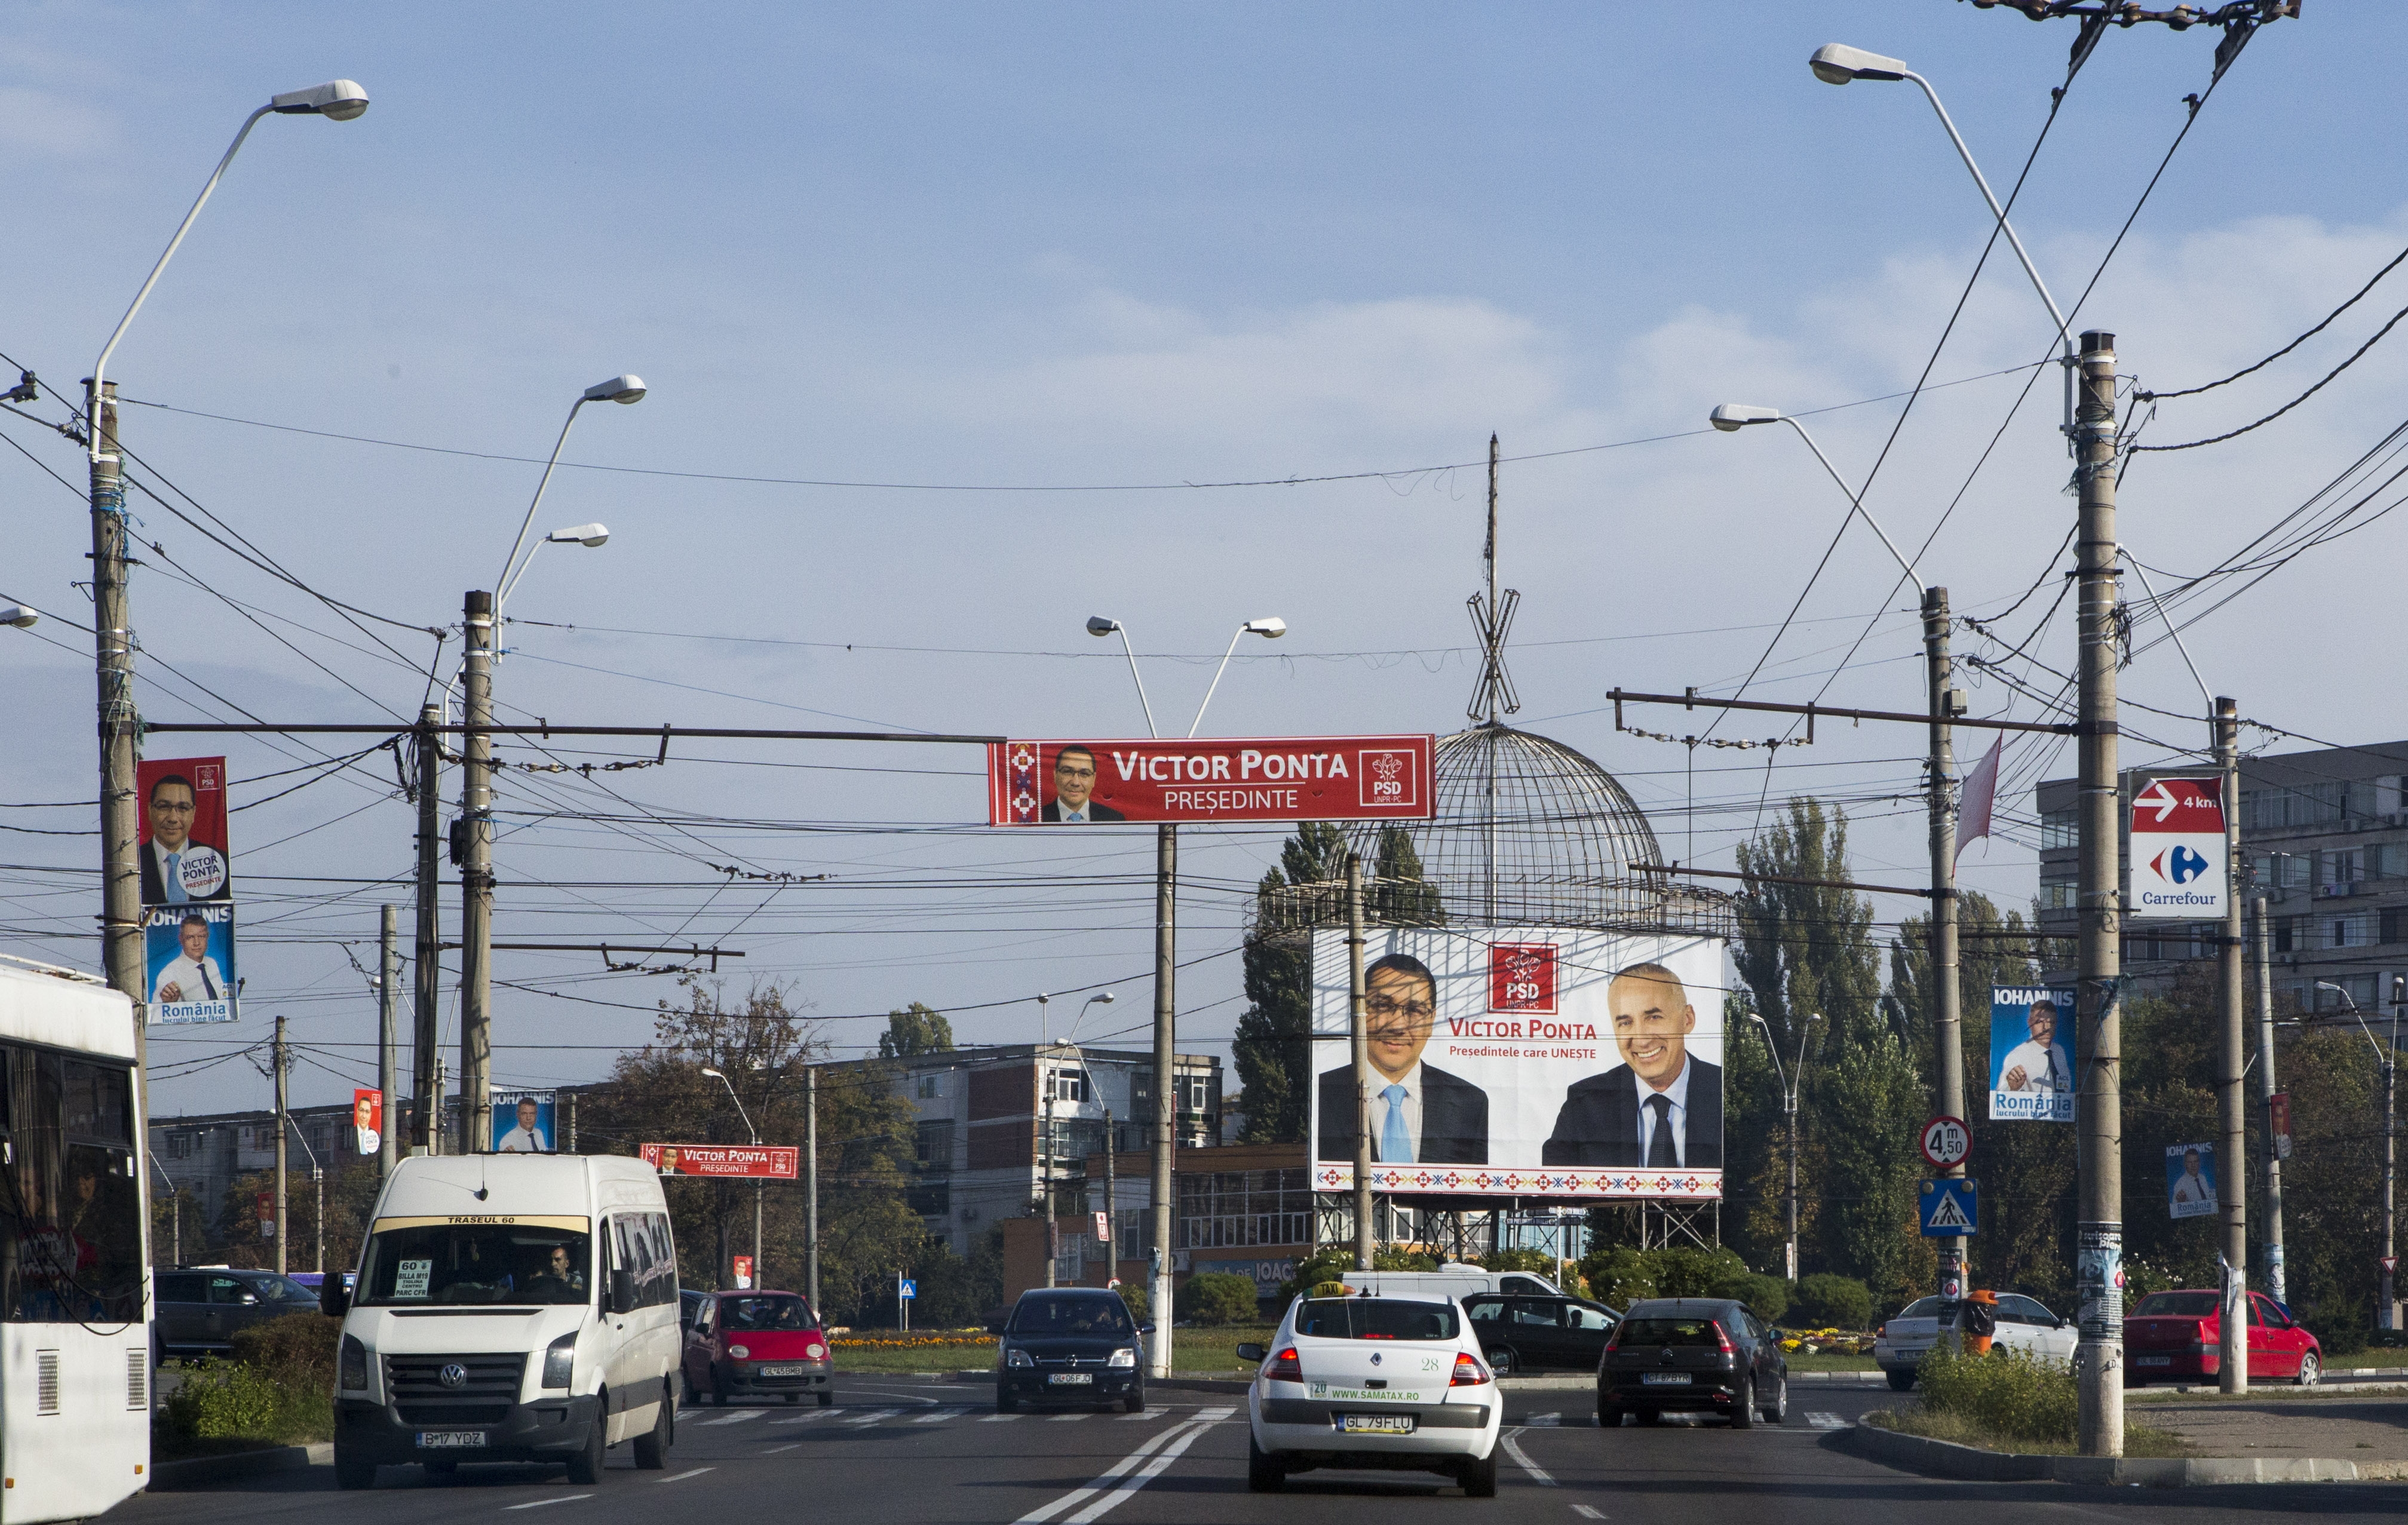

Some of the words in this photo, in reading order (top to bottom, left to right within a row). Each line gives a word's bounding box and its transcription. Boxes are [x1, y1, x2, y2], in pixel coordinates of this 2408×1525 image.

[1113, 751, 1231, 781] VICTOR
[1241, 750, 1349, 780] PONTA
[1374, 781, 1401, 795] PSD
[1164, 789, 1299, 815] PREȘEDINTE
[2184, 796, 2194, 808] 4
[2196, 796, 2217, 808] km
[181, 855, 218, 870] VICTOR
[183, 864, 220, 880] PONTA
[2142, 892, 2216, 904] Carrefour
[1507, 983, 1539, 999] PSD
[1994, 989, 2074, 1007] IOHANNIS
[162, 1002, 226, 1017] România
[1448, 1017, 1523, 1038] VICTOR
[1529, 1019, 1597, 1040] PONTA
[1450, 1045, 1520, 1059] Președintele
[1523, 1049, 1547, 1058] care
[1551, 1048, 1597, 1061] UNEȘTE
[1996, 1094, 2072, 1111] România
[2031, 1109, 2048, 1118] bine
[1947, 1128, 1958, 1139] m
[684, 1149, 725, 1161] VICTOR
[729, 1150, 768, 1162] PONTA
[2177, 1202, 2211, 1211] România
[401, 1262, 417, 1271] 60
[1320, 1283, 1338, 1295] TAXI
[1422, 1357, 1438, 1371] 28
[1332, 1390, 1419, 1400] WWW.SAMATAX.RO
[1346, 1416, 1363, 1428] GL
[425, 1434, 434, 1444] B
[439, 1434, 450, 1444] 17
[455, 1434, 480, 1445] YDZ
